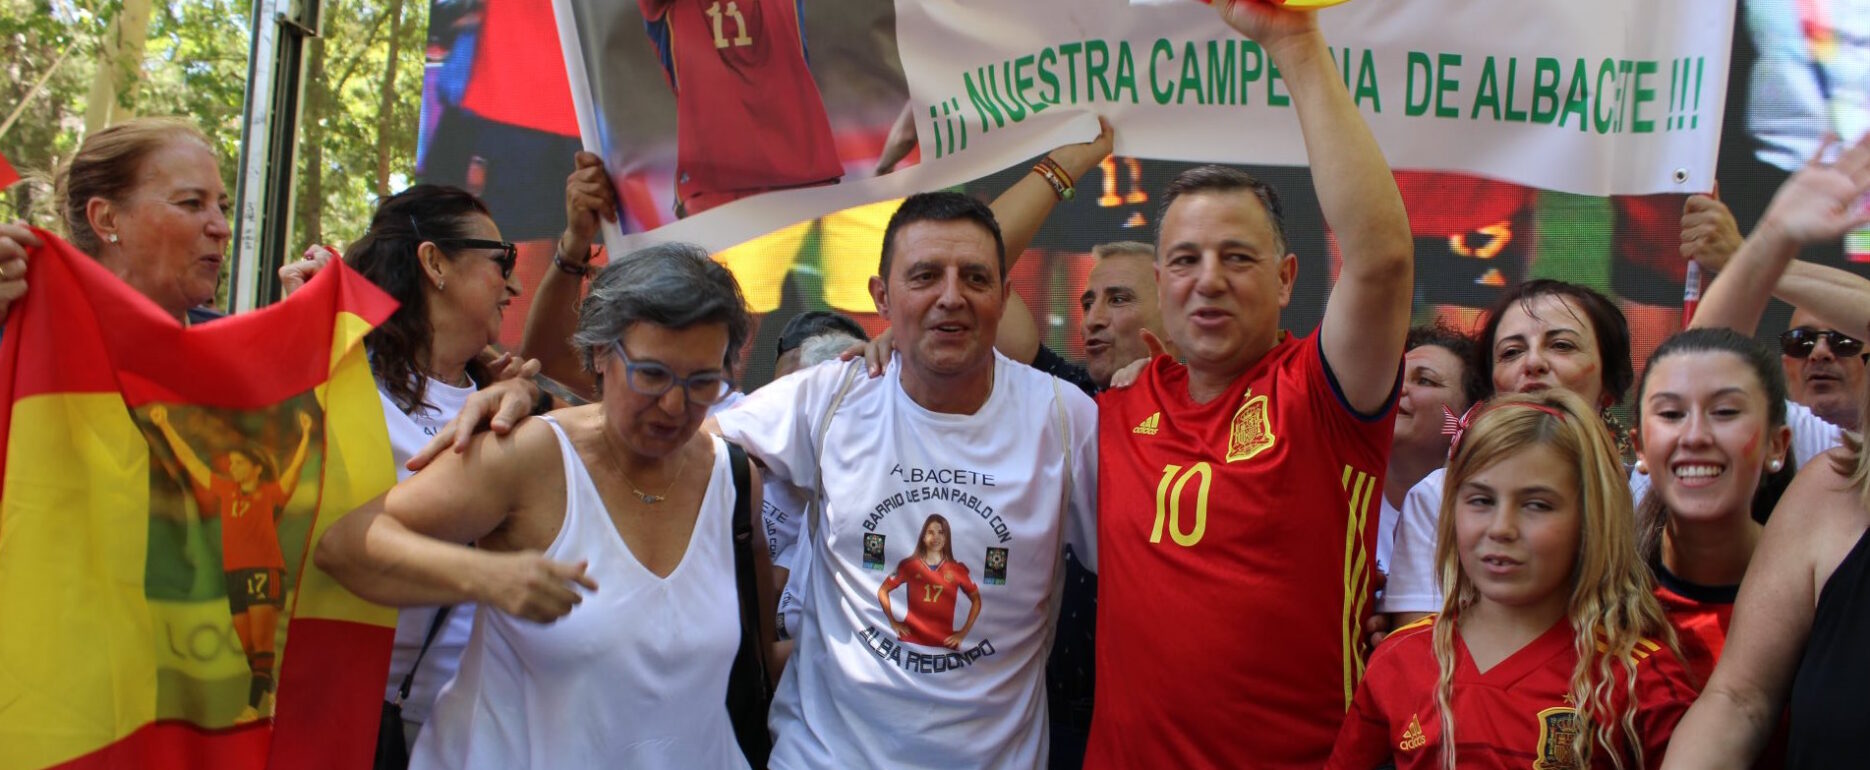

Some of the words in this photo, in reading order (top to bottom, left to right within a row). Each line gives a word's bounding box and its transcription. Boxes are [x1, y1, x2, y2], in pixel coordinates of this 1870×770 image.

[705, 0, 753, 48] 11
[963, 39, 1139, 133] NUESTRA
[1150, 38, 1381, 113] CAMPENA
[1405, 51, 1462, 118] DE
[1132, 426, 1159, 436] adidas
[863, 492, 905, 532] BARRIO
[922, 486, 949, 501] SAN
[950, 488, 993, 520] PABLO
[989, 515, 1012, 543] CON
[1149, 461, 1212, 547] 10
[247, 572, 268, 595] 17
[923, 584, 945, 603] 17
[859, 625, 901, 666] ALBA
[904, 638, 996, 673] REDONDO
